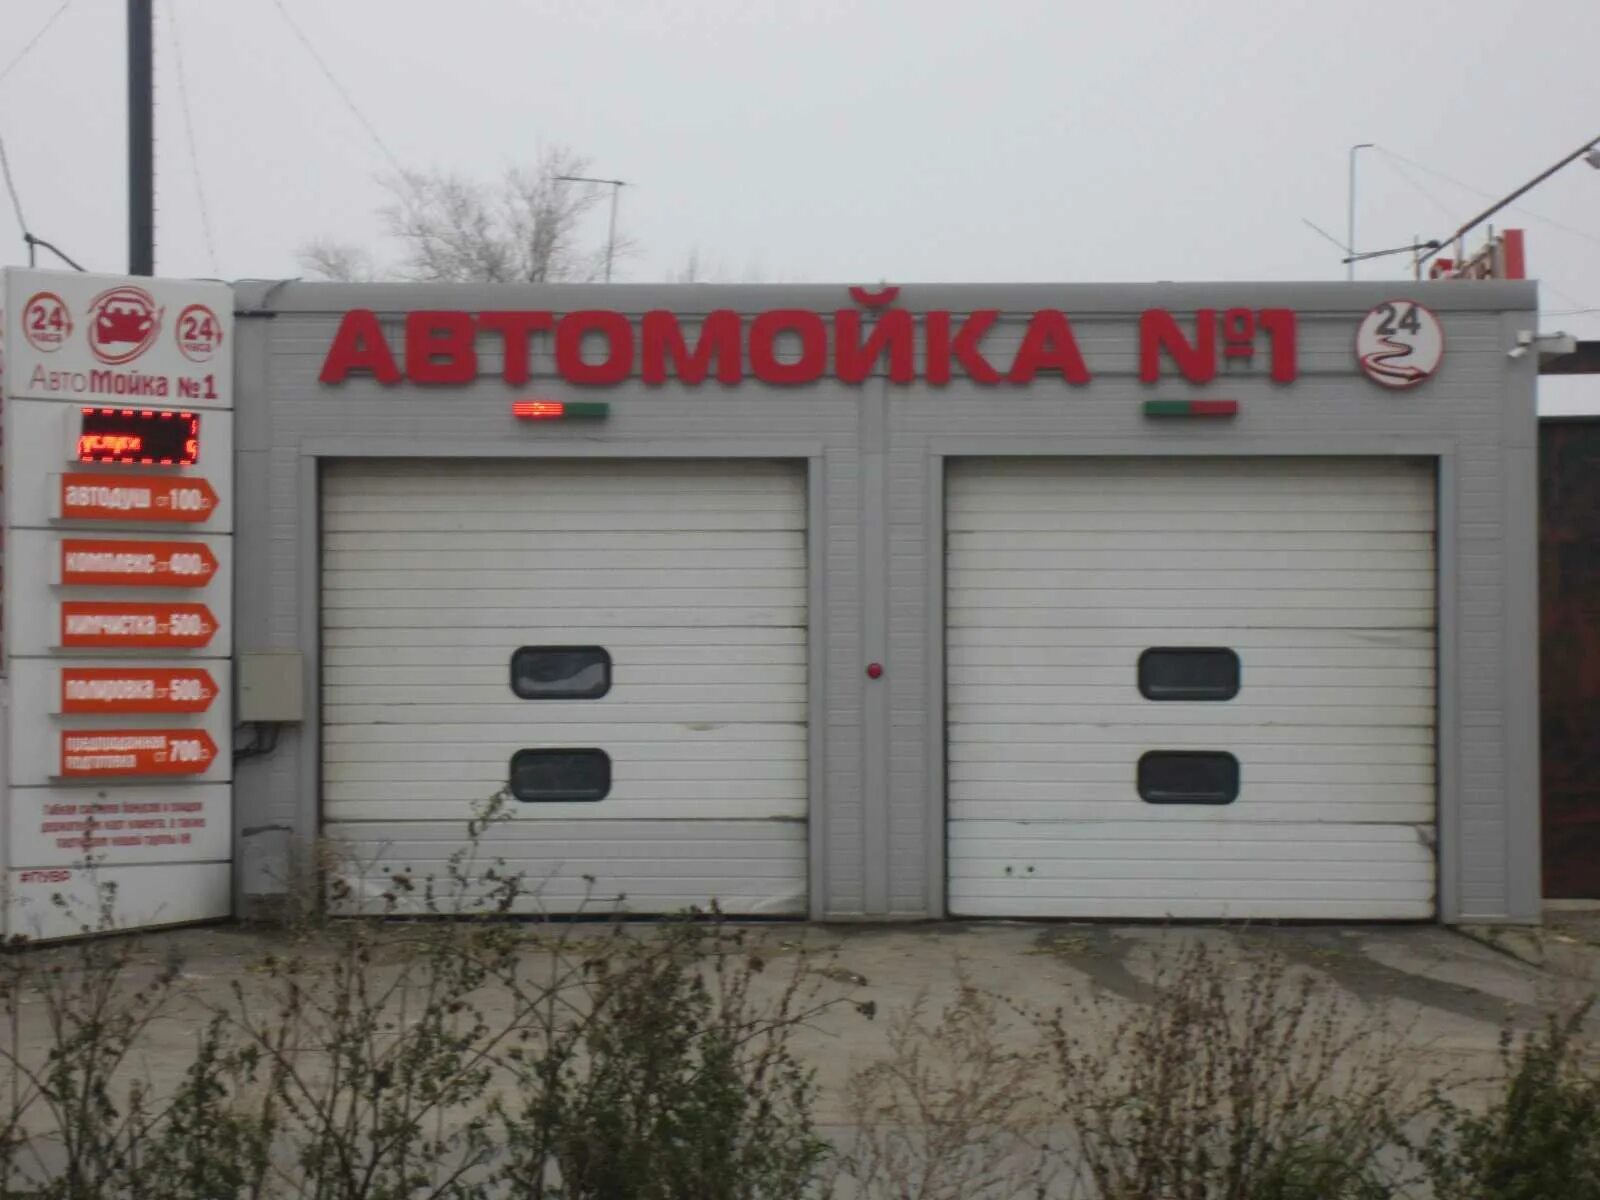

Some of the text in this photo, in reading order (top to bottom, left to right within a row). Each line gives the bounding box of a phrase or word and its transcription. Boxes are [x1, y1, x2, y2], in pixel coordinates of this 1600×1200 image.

[32, 305, 63, 331] 24
[184, 317, 213, 341] 24
[1375, 303, 1421, 335] 24
[319, 285, 1090, 385] АВТОМОЙКА
